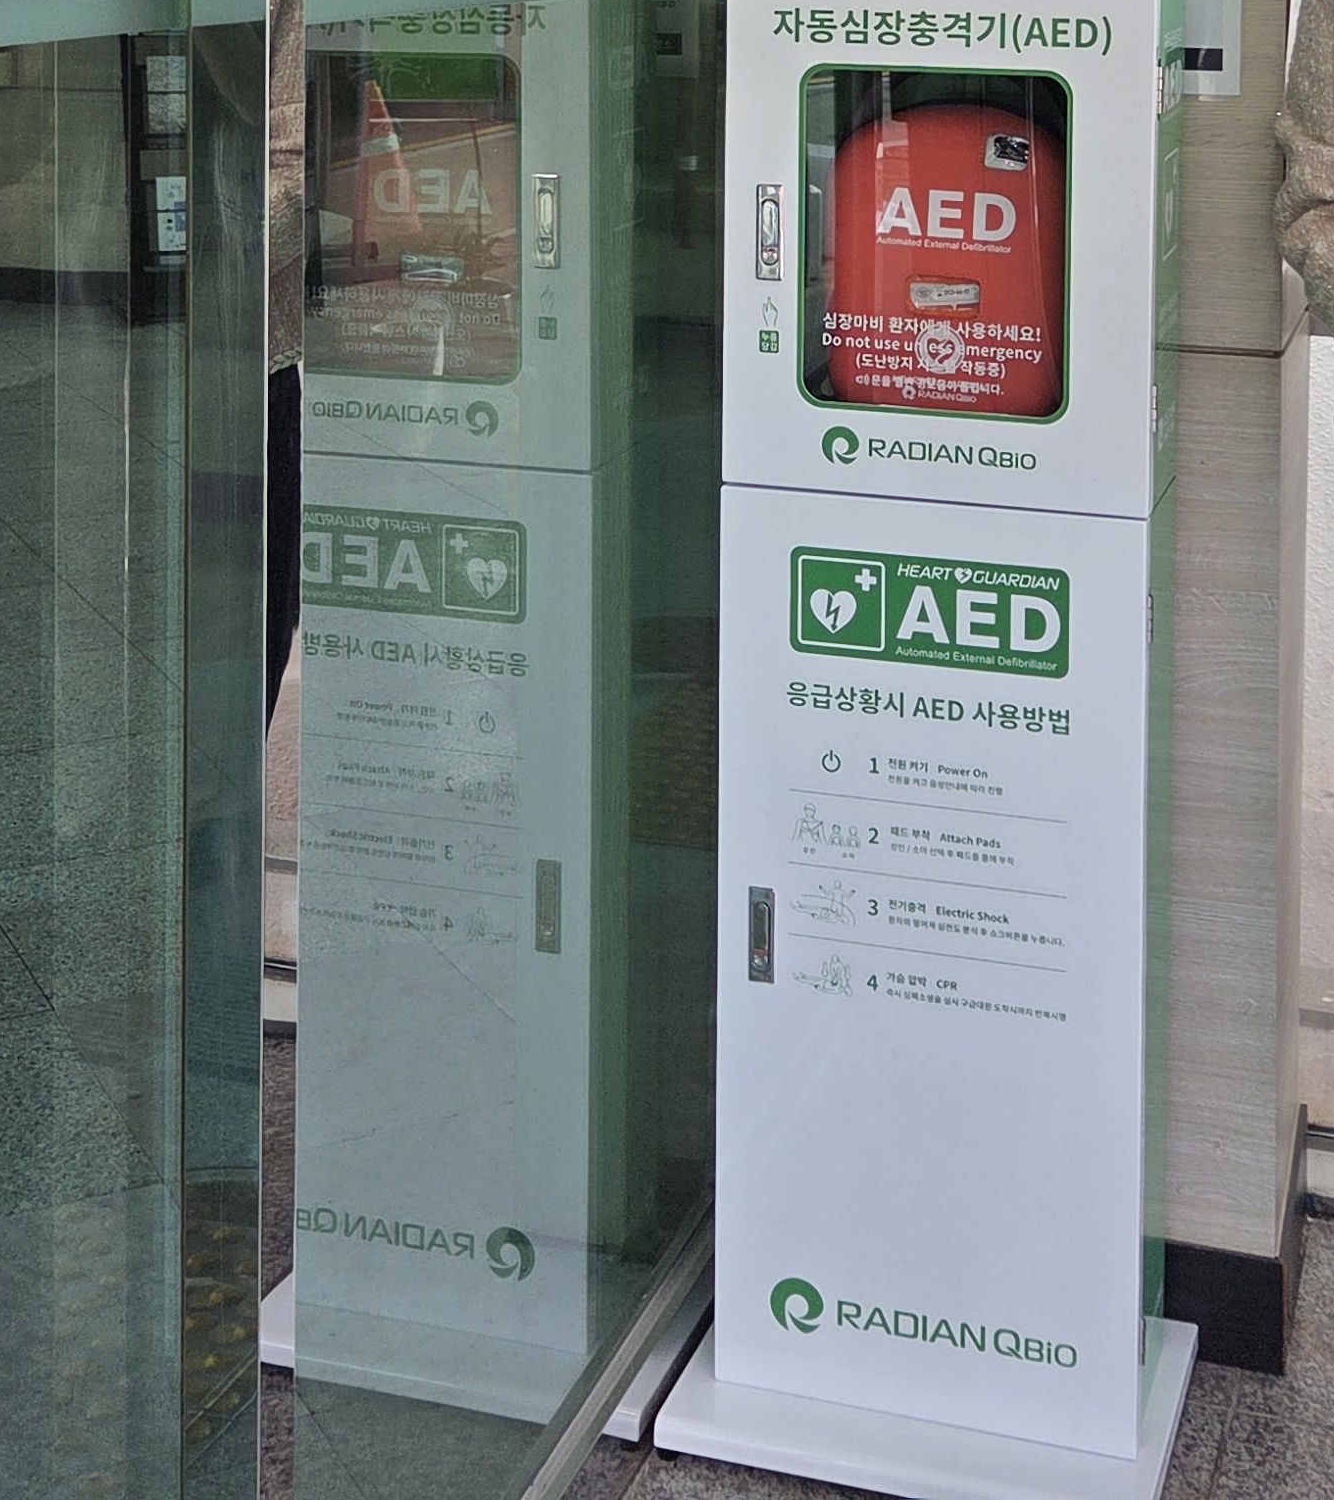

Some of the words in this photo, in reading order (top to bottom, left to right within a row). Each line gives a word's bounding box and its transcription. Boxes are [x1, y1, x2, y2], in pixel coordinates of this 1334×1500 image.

[772, 8, 1113, 56] 자동심장충격기(AED)
[877, 186, 1016, 242] AED
[876, 236, 922, 248] Automated
[924, 239, 960, 250] External
[961, 242, 1012, 254] Defibrillator
[822, 312, 883, 333] 심장마비
[957, 321, 1042, 342] 사용하세요!
[822, 332, 842, 347] Do
[846, 335, 871, 349] not
[874, 338, 901, 351] use
[856, 353, 913, 371] (도난방지
[959, 360, 1006, 379] 작동중)
[868, 438, 973, 465] RADIAN
[897, 563, 952, 581] HEART
[973, 569, 1060, 591] GUARDIAN
[896, 585, 1061, 653] AED
[895, 645, 950, 661] Automated
[953, 651, 995, 665] External
[997, 656, 1057, 672] Defibrillator
[786, 681, 906, 719] 응급상황시
[912, 696, 965, 722] AED
[972, 700, 1071, 736] 사용방법
[869, 757, 880, 774] 1
[887, 757, 907, 771] 전원
[937, 764, 971, 778] Power
[972, 768, 989, 780] On
[868, 827, 880, 845] 2
[939, 832, 974, 846] Attach
[975, 837, 1002, 849] Pads
[867, 899, 879, 916] 3
[935, 905, 975, 920] Electric
[977, 911, 1010, 925] Shock
[866, 974, 879, 992] 4
[886, 971, 906, 984] 가슴
[936, 978, 958, 992] CPR
[836, 1299, 987, 1353] RADIAN
